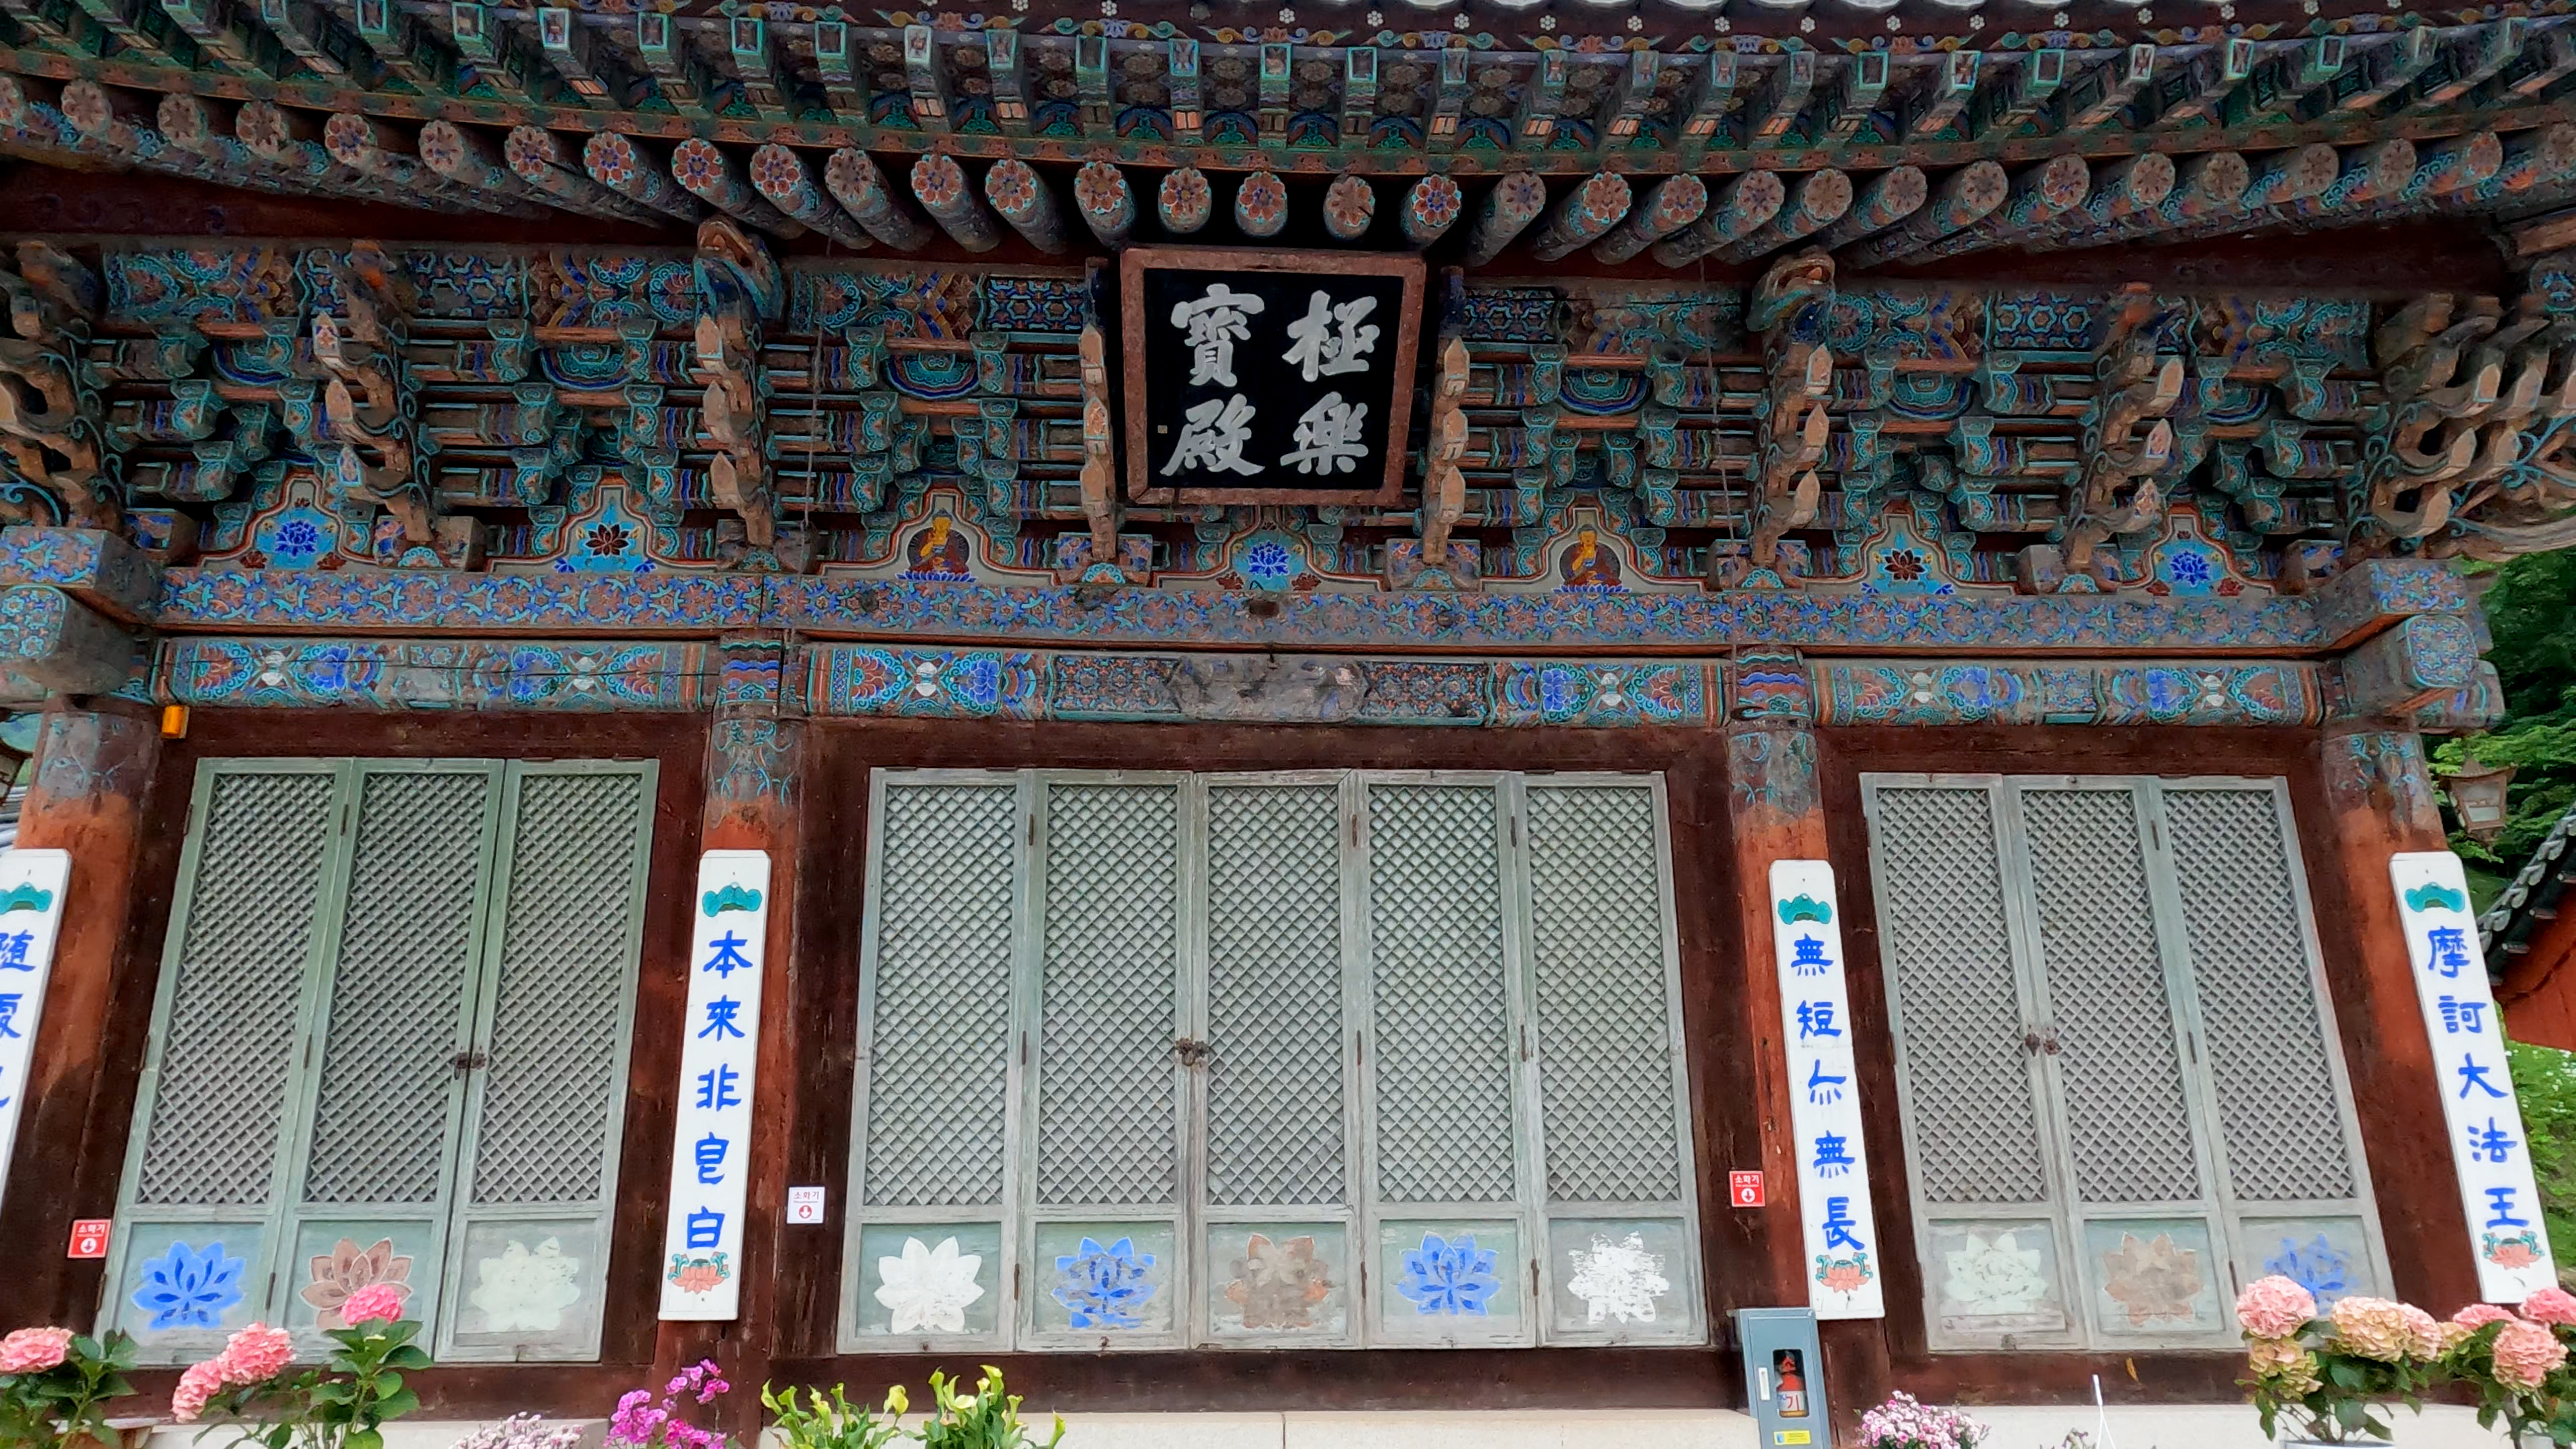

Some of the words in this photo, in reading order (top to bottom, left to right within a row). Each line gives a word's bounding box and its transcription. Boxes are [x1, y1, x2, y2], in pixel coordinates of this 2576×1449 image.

[1735, 1175, 1759, 1184] 소화기
[794, 1191, 819, 1199] 소화기
[78, 1224, 105, 1233] 소화기
